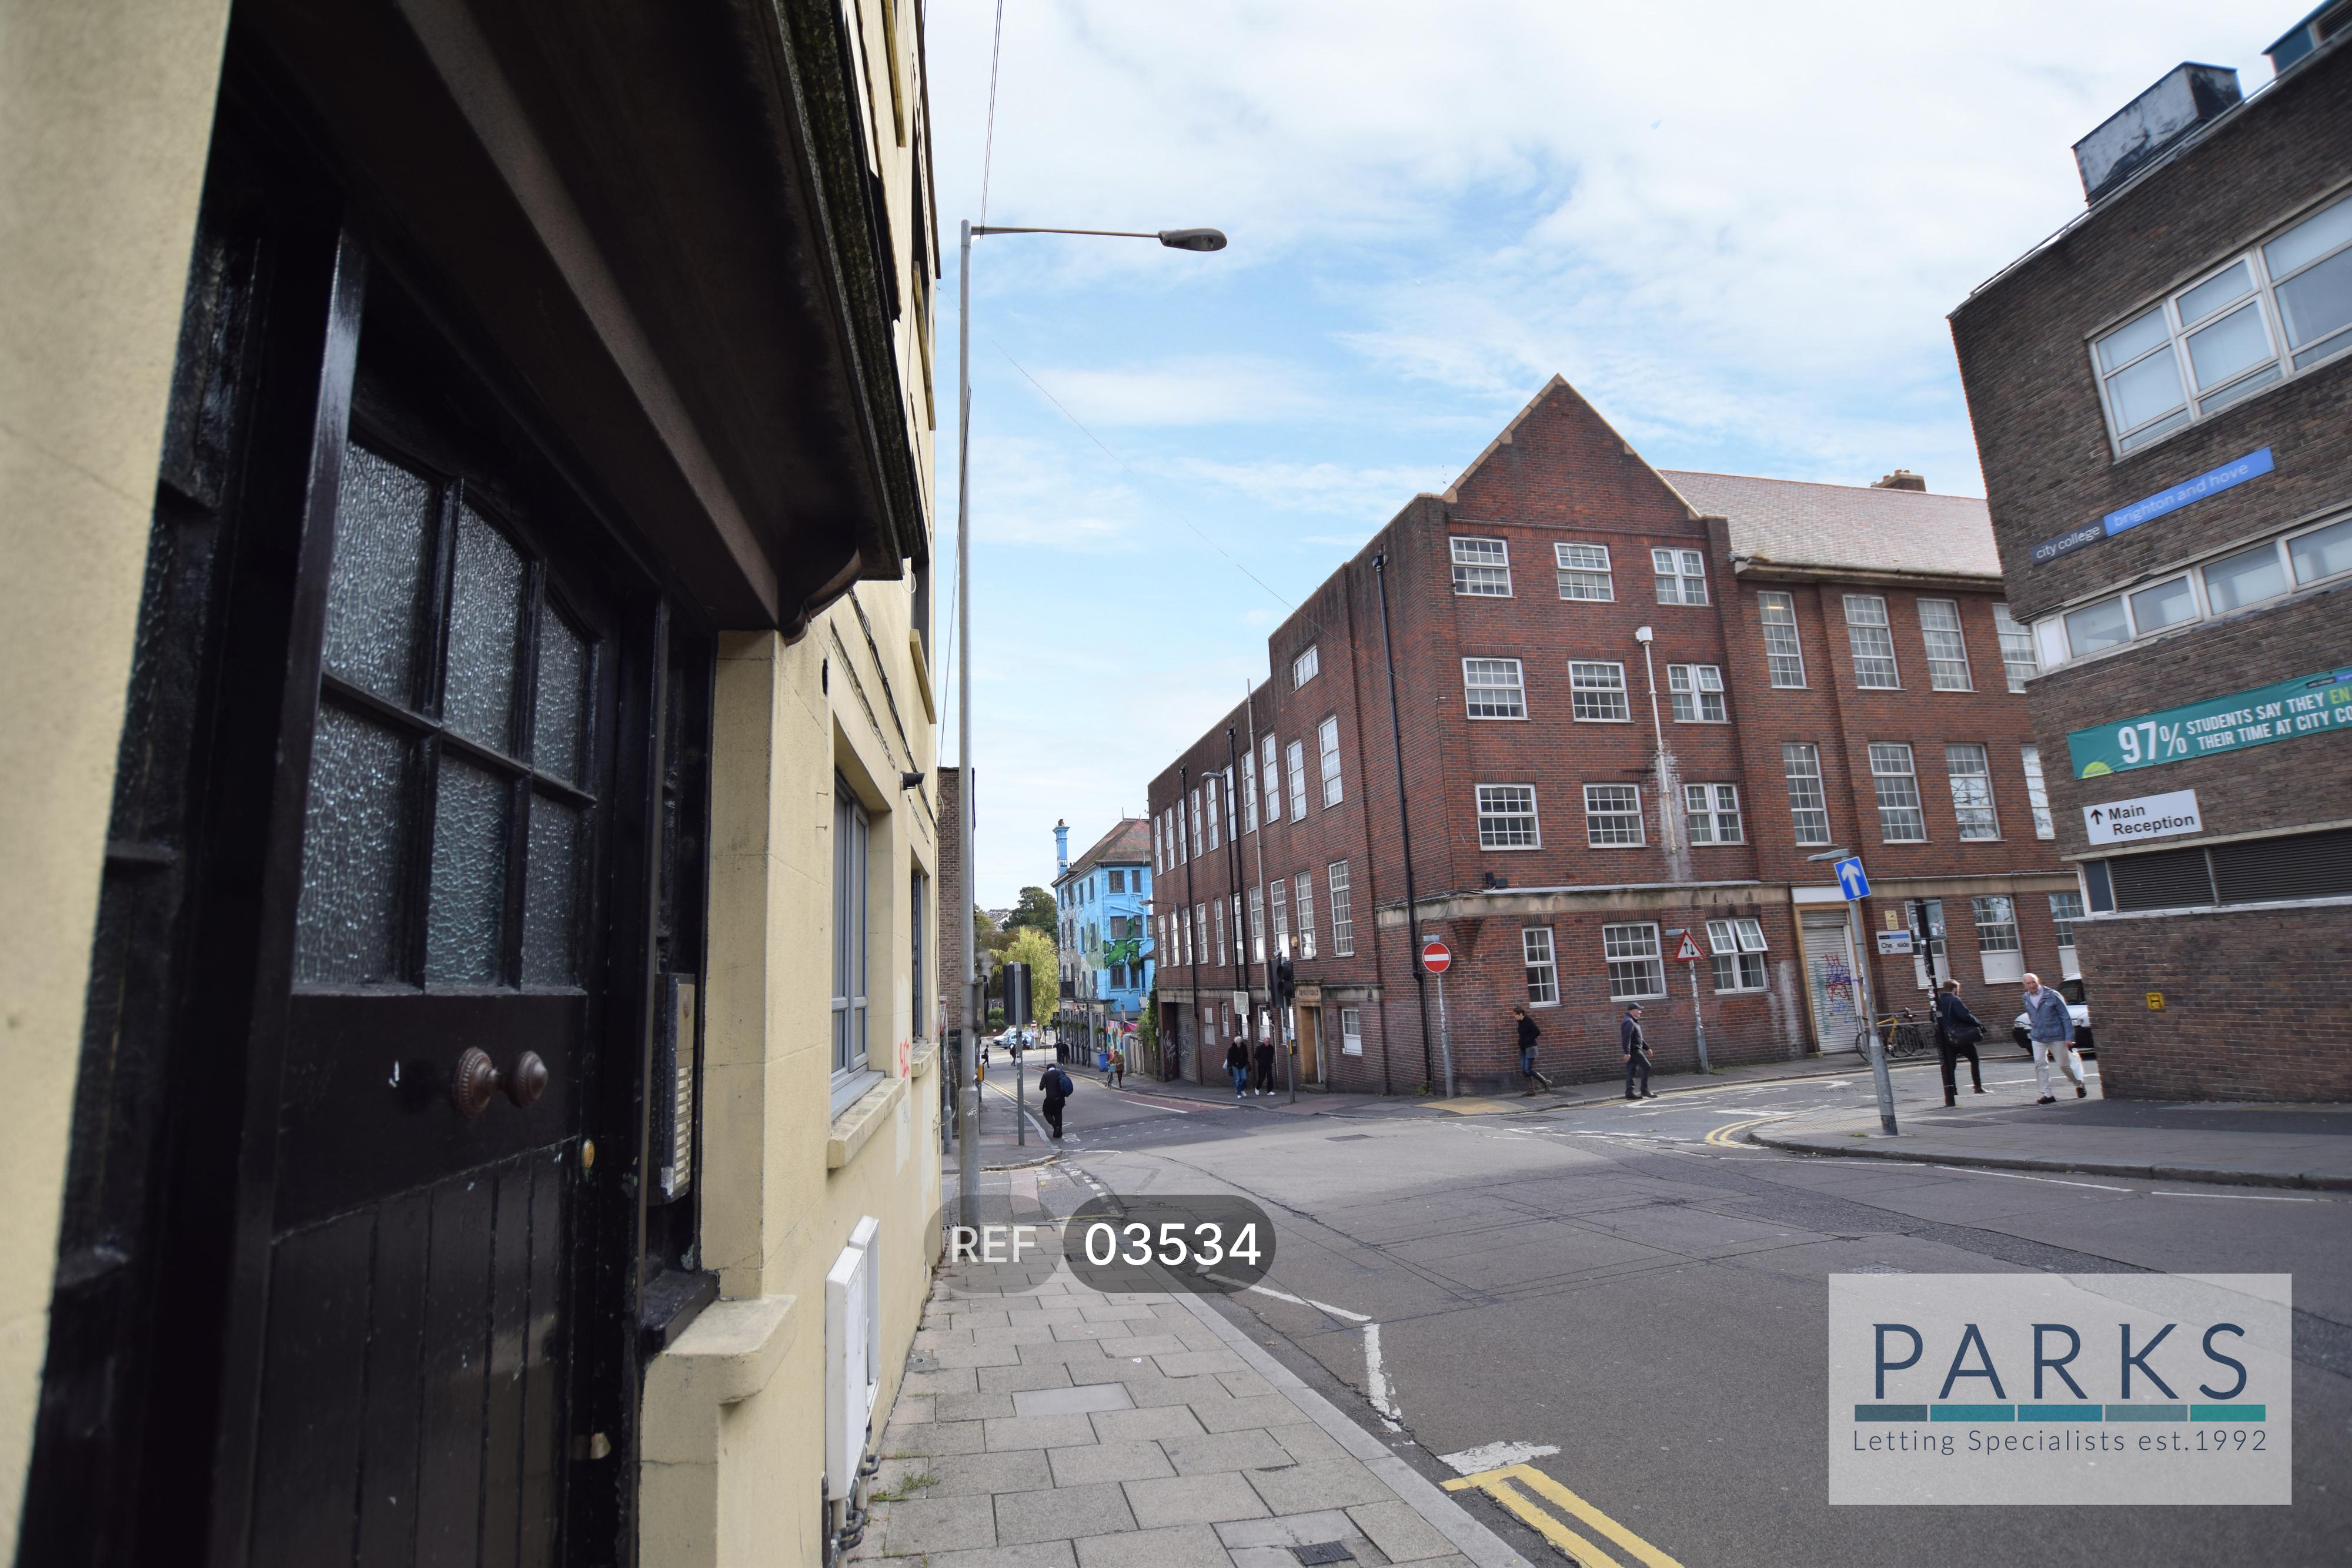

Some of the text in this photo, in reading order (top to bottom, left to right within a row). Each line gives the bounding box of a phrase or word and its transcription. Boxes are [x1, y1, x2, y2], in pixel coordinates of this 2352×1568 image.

[2036, 464, 2249, 559] city college brighton and hove
[2186, 686, 2352, 735] STUDENTS SAY THEY EN
[2196, 731, 2236, 750] THEIR
[2237, 723, 2273, 742] TIME
[2275, 718, 2292, 735] AT
[2295, 710, 2330, 731] CITY
[2117, 721, 2187, 764] 97%
[2108, 805, 2146, 821] Main
[2112, 815, 2195, 835] Reception
